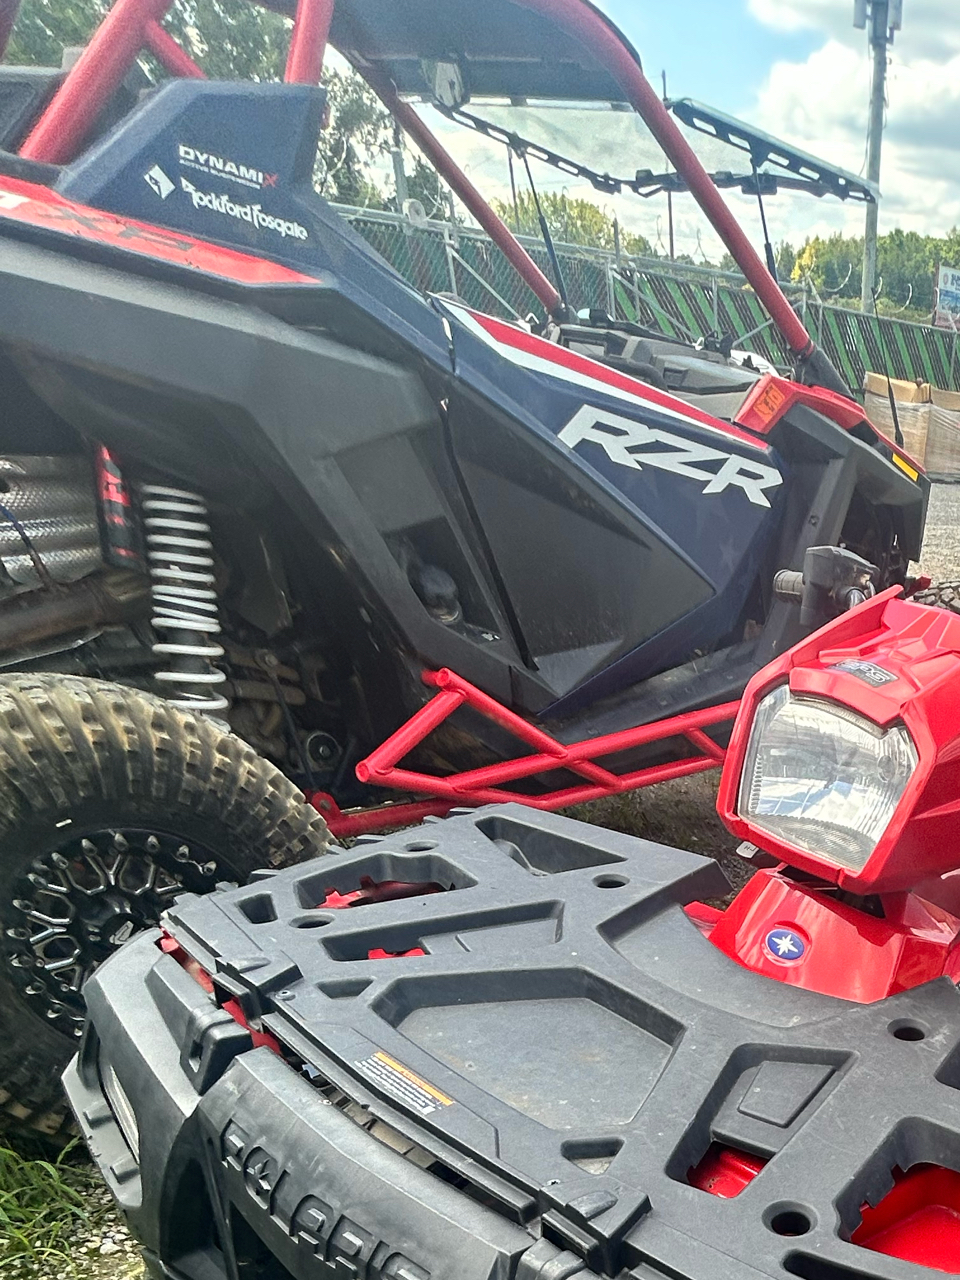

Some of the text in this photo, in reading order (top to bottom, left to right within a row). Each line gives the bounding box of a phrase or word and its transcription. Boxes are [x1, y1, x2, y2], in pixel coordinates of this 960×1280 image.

[179, 144, 278, 187] DYNAMIX
[180, 177, 309, 241] Rockford Fosgate
[557, 404, 784, 508] RZR
